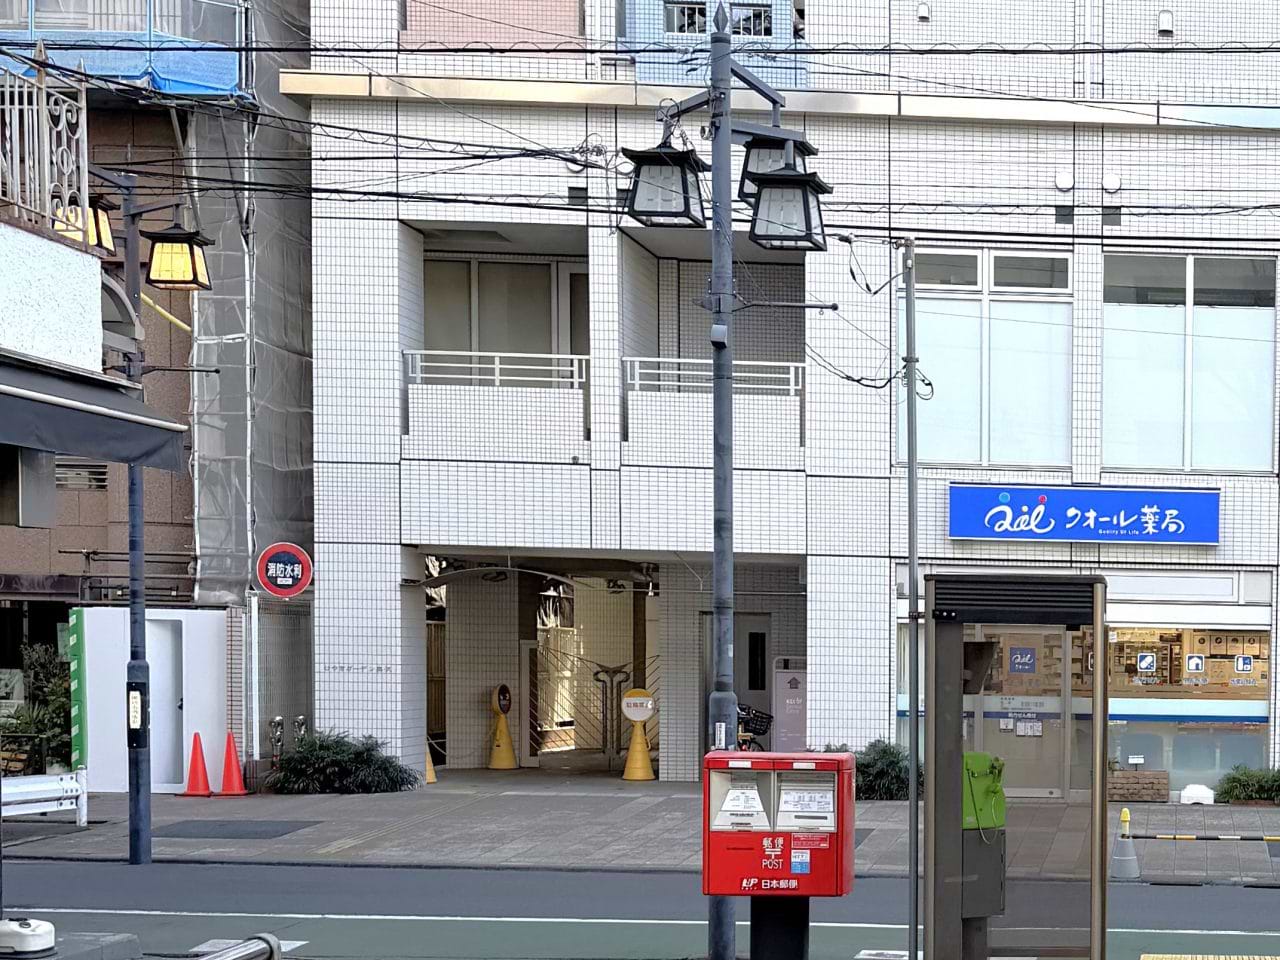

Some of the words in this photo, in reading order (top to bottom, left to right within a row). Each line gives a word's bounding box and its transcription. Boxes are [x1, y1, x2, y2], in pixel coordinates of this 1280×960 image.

[1065, 505, 1186, 534] クオール薬局
[267, 562, 302, 578] 消防水利
[762, 837, 784, 849] 郵便
[762, 858, 784, 870] POST
[761, 879, 799, 889] 日本郵便
